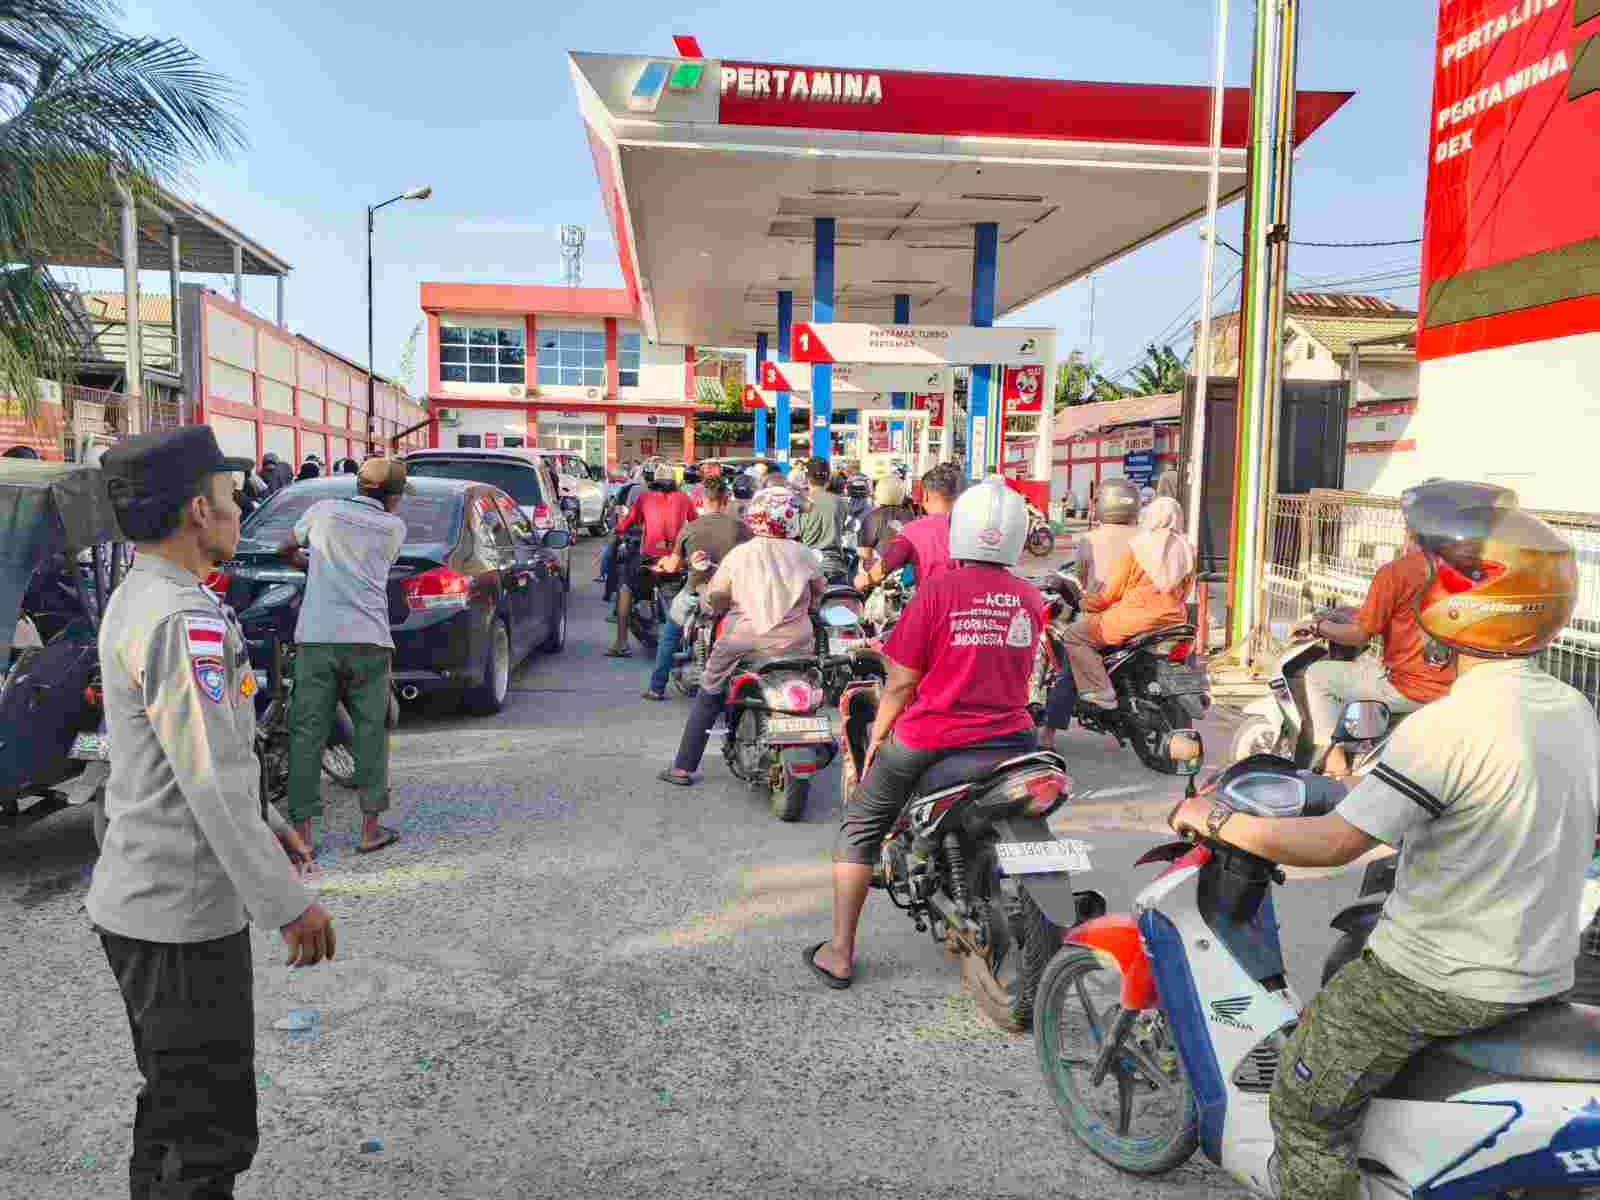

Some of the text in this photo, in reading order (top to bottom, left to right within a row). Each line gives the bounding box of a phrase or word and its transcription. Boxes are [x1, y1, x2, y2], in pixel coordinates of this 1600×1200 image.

[720, 67, 883, 103] PERTAMINA
[1438, 49, 1568, 130] PERTAMINA
[1435, 128, 1473, 164] DEX
[799, 332, 809, 352] 1
[985, 592, 1021, 607] ACEH
[951, 631, 1004, 648] INDONESIA
